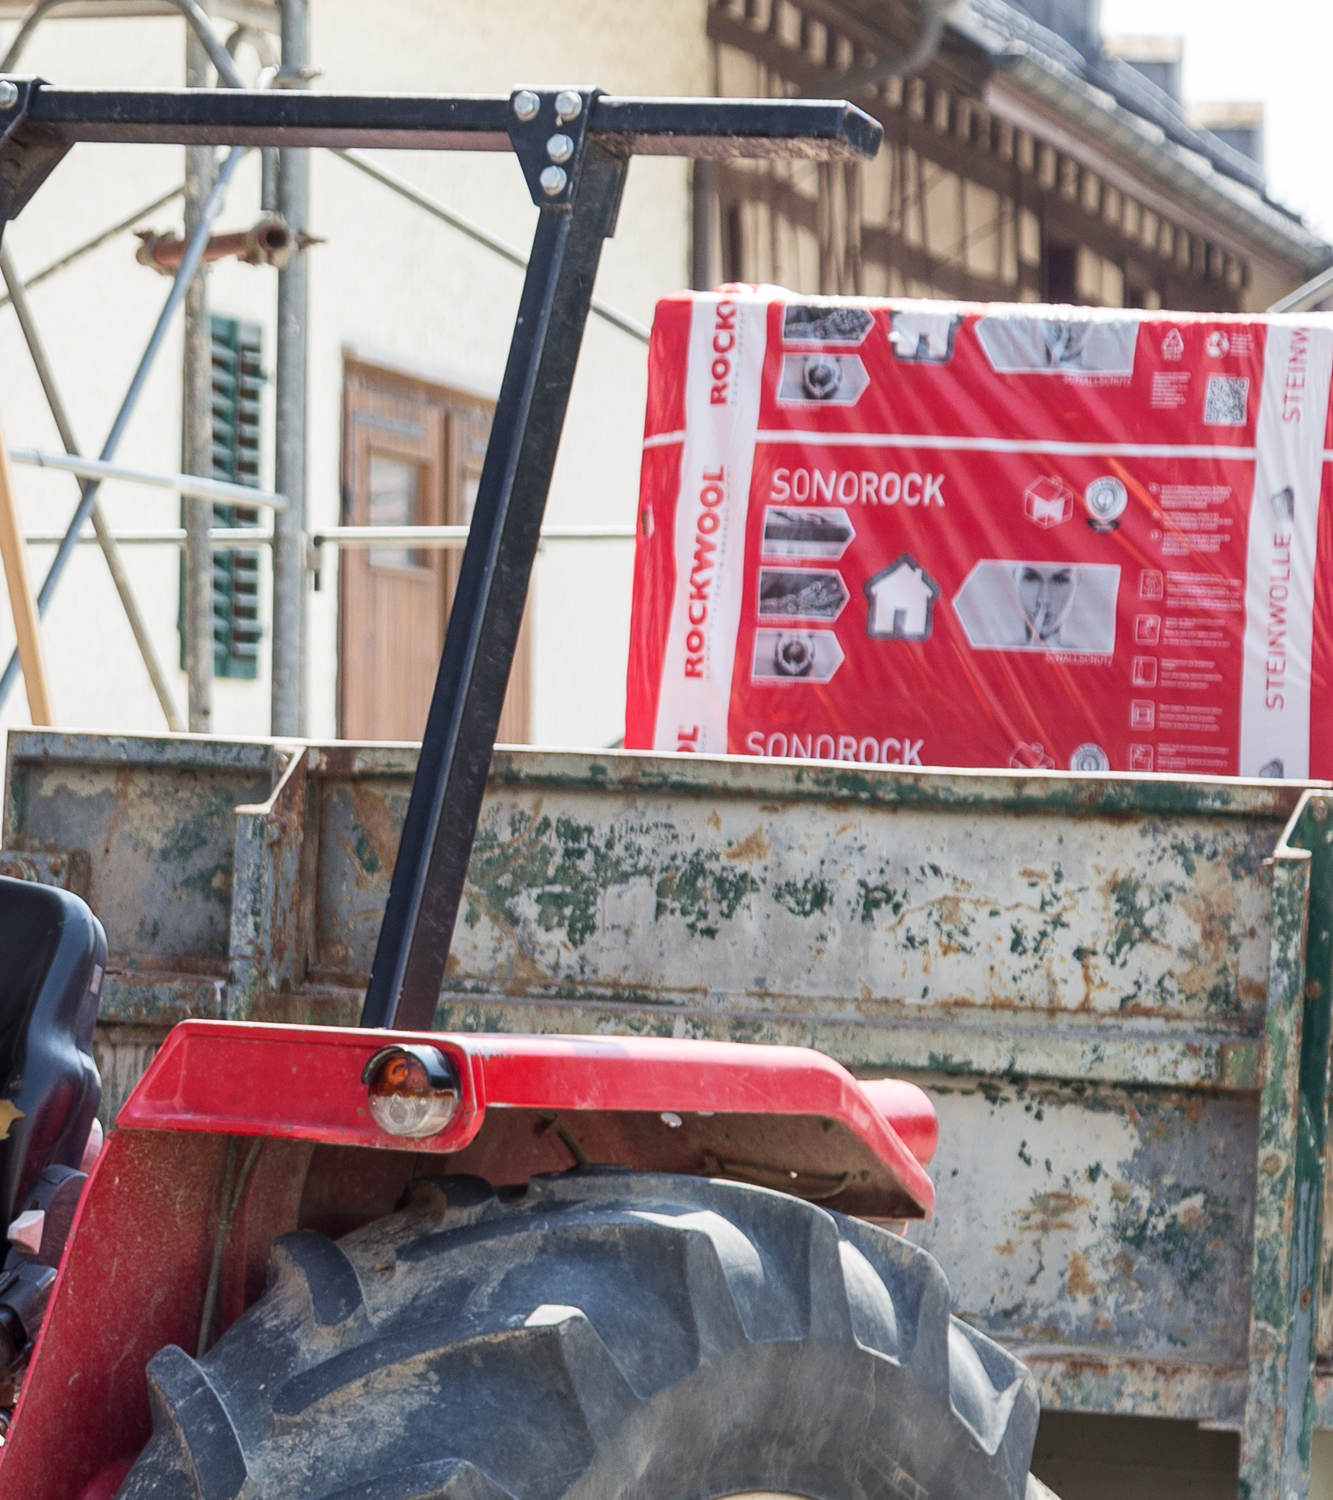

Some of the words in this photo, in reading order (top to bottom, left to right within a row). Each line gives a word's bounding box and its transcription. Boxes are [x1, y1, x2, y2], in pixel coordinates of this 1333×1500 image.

[709, 300, 737, 405] ROCK
[770, 467, 945, 507] SONOROCK
[684, 464, 725, 679] ROCKWOOL
[1264, 532, 1292, 711] STEINWOLLE
[746, 731, 925, 766] SONOROCK
